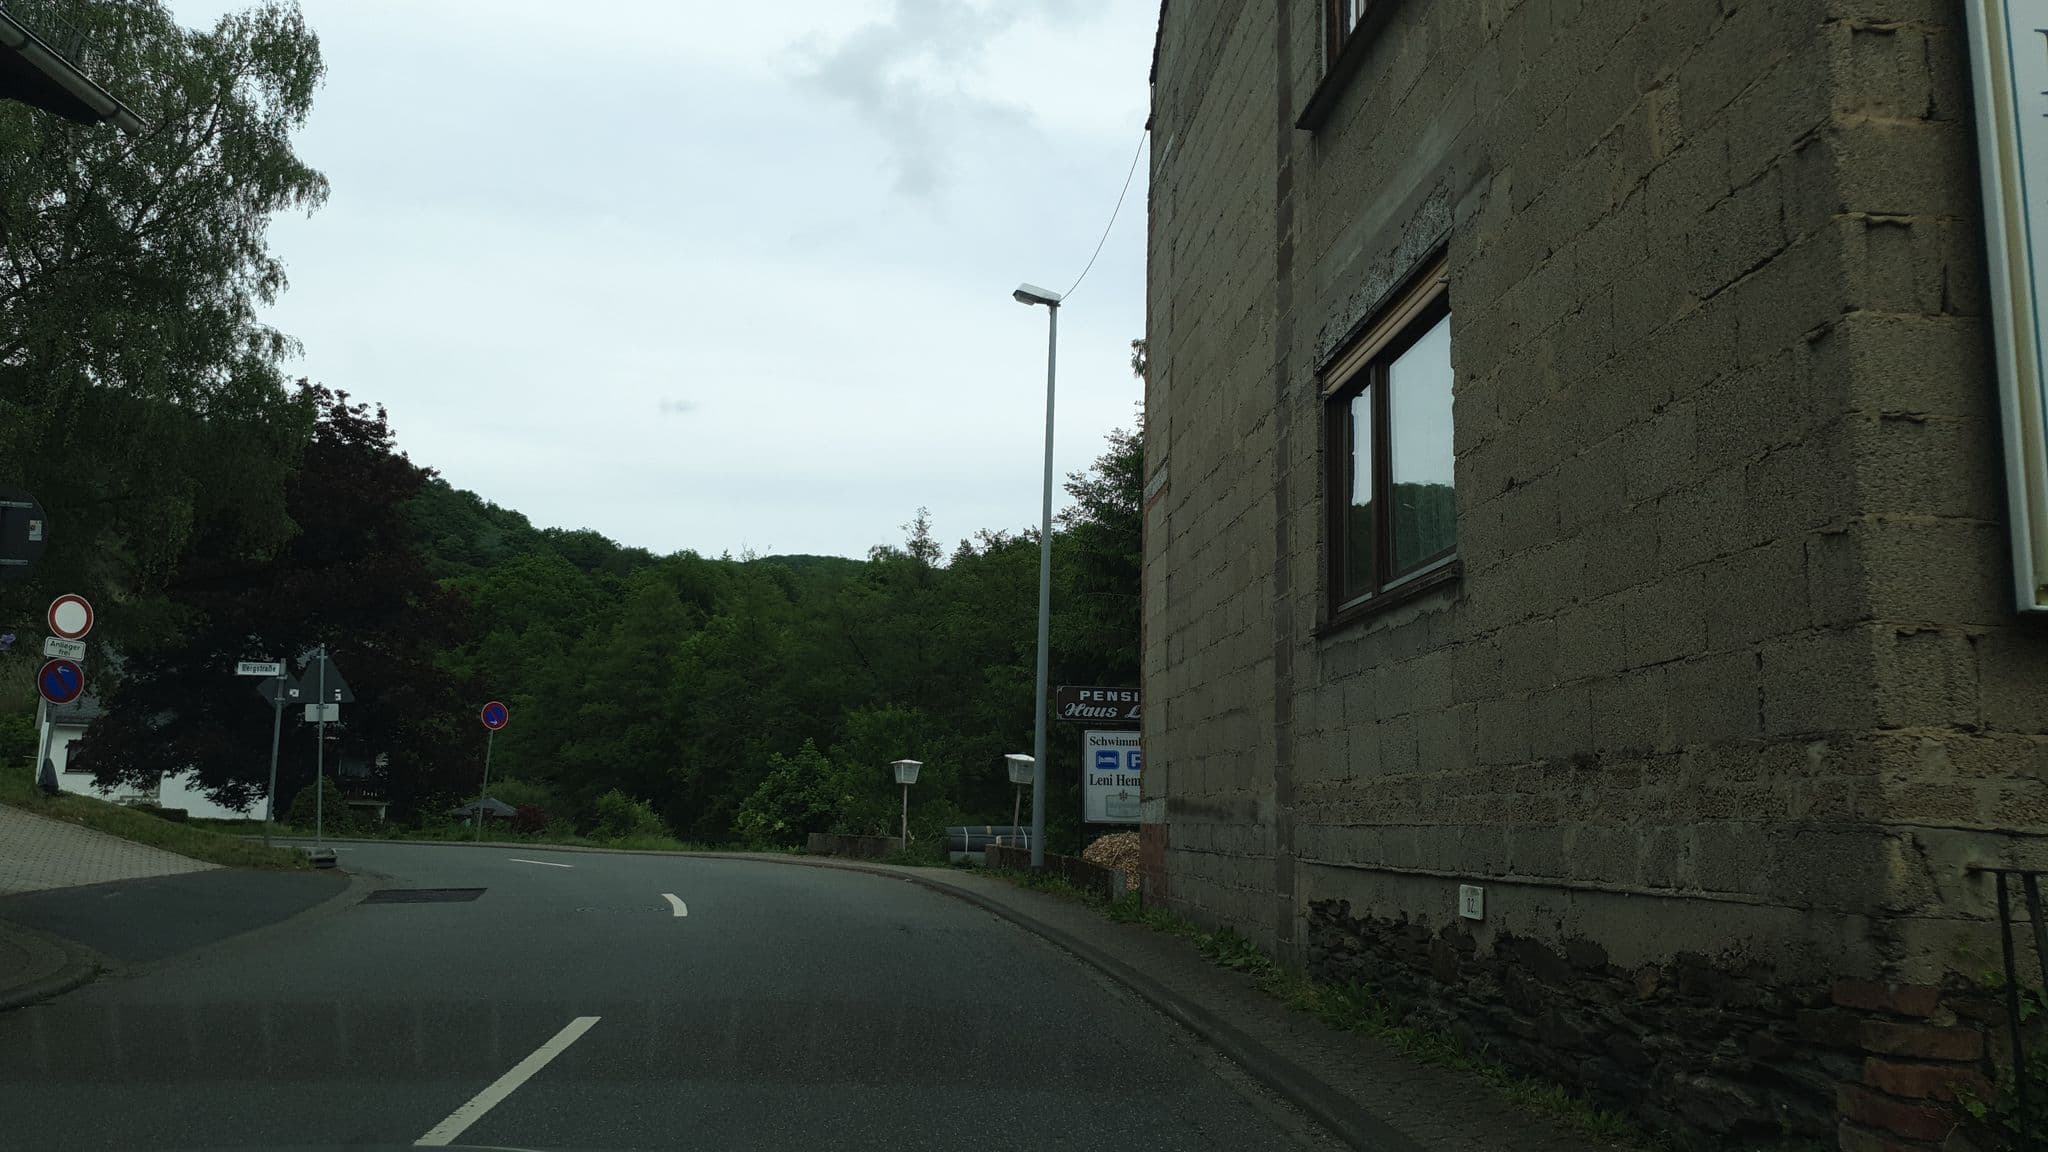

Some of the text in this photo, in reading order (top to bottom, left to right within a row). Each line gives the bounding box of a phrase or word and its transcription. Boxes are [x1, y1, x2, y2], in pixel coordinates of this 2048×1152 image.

[50, 640, 81, 651] Anlieger
[58, 649, 71, 657] frei
[1065, 702, 1118, 718] Haus
[1089, 773, 1113, 786] Leni
